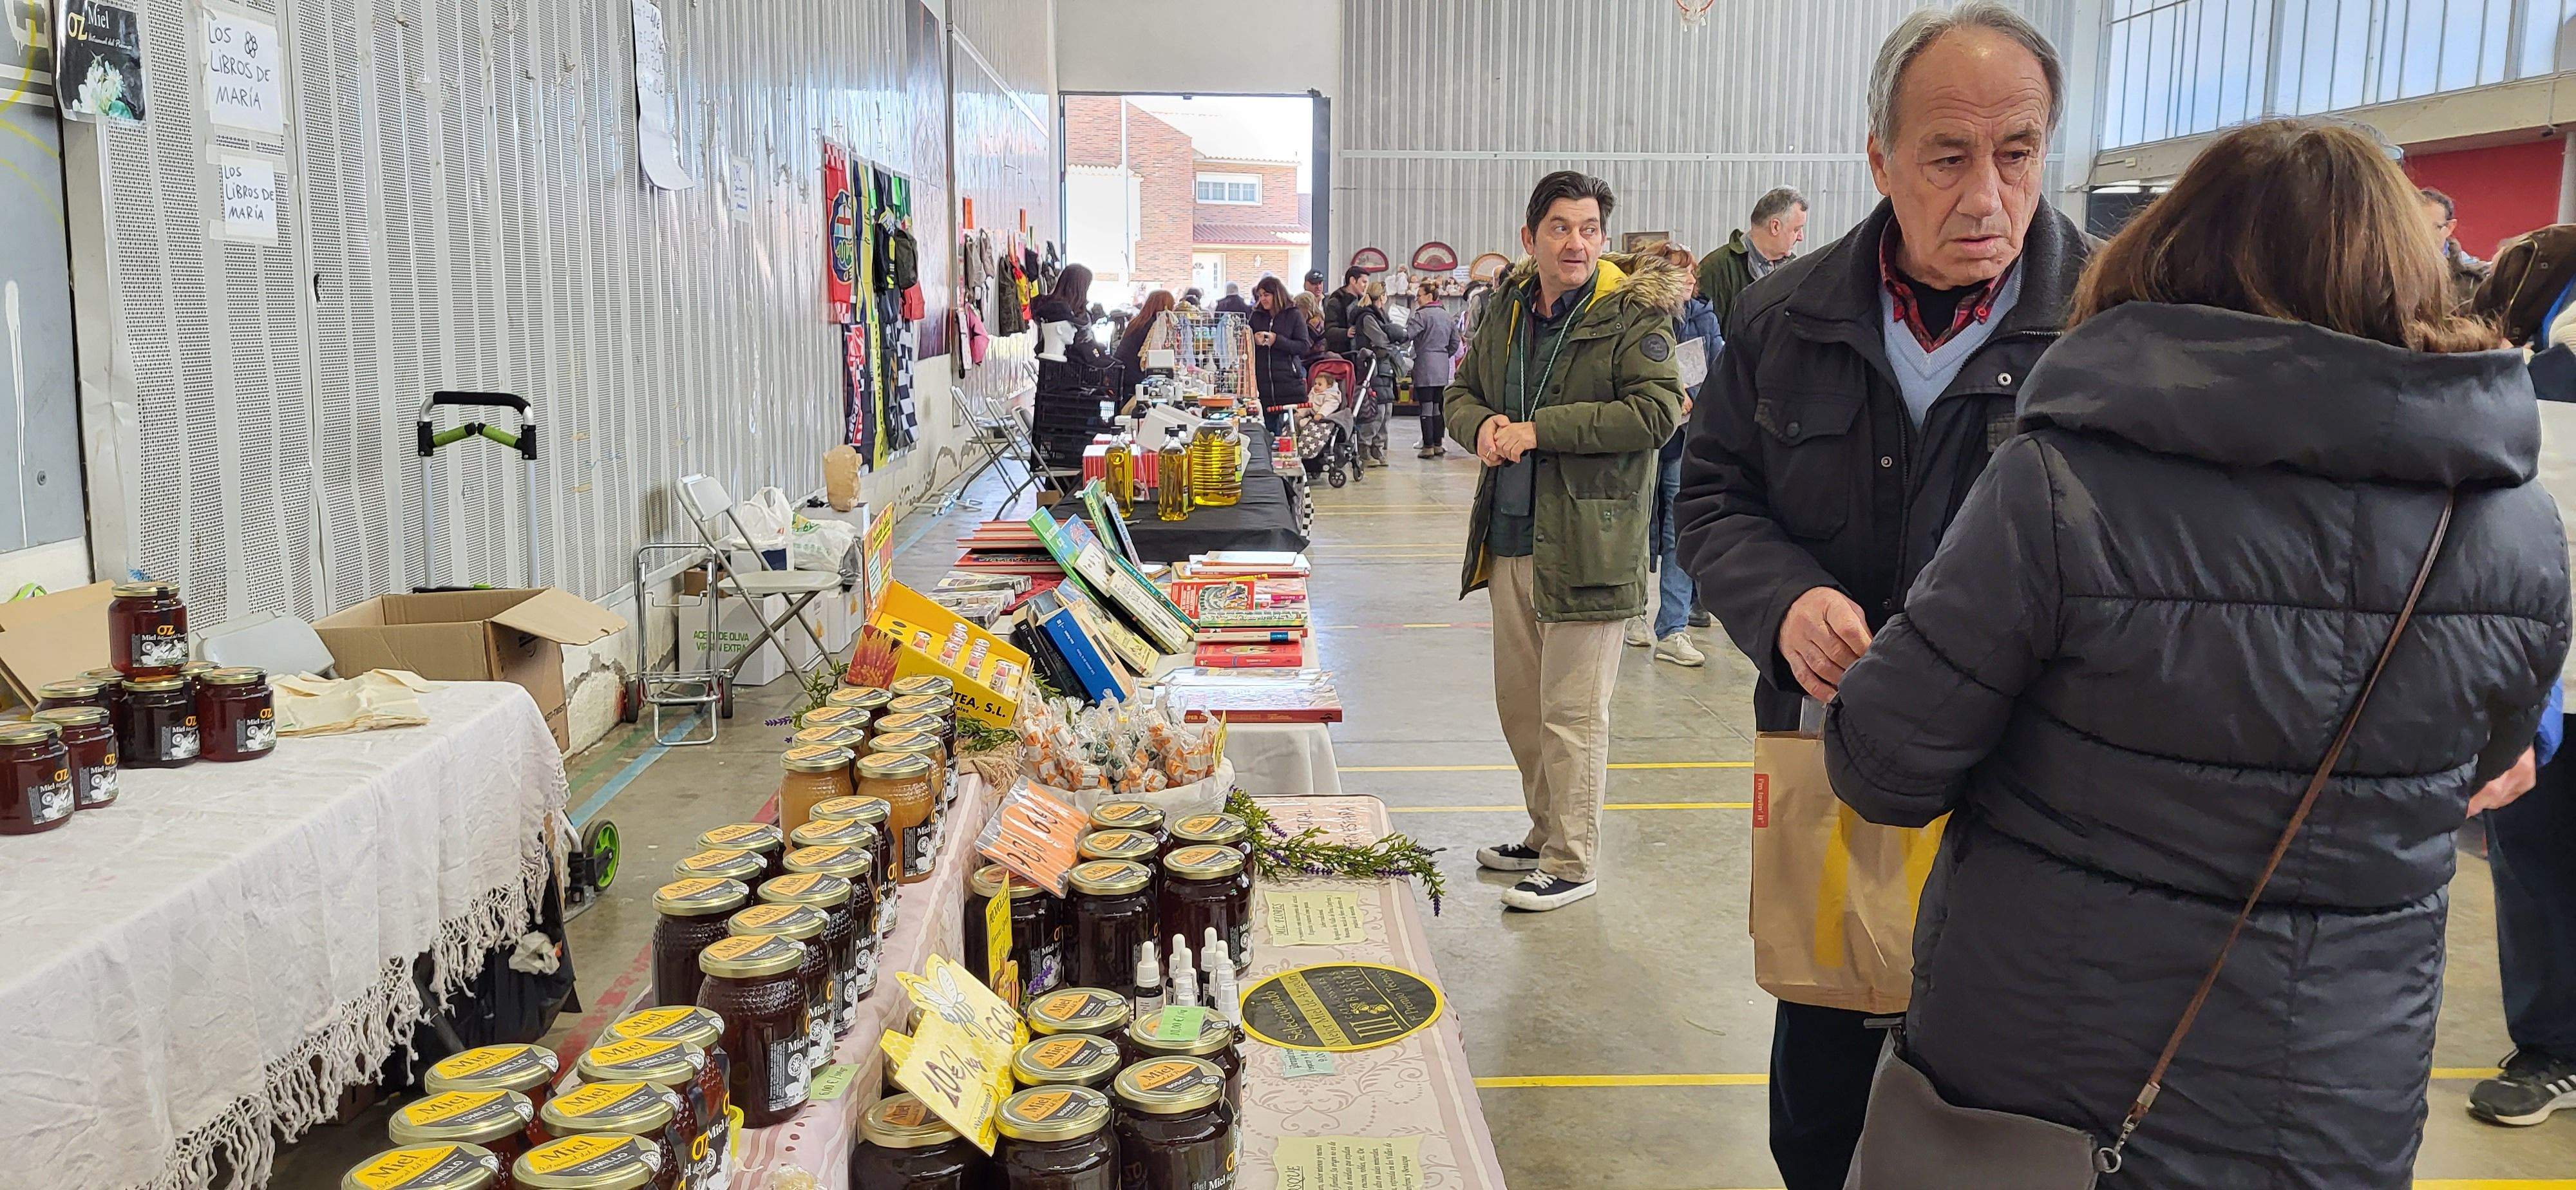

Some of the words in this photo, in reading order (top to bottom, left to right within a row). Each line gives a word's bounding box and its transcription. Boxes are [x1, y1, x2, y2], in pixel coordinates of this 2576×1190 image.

[88, 3, 109, 29] Miel
[209, 21, 232, 44] LOS
[256, 66, 270, 82] DE
[216, 86, 261, 111] MARÍA
[224, 165, 242, 180] LOS
[262, 188, 274, 201] DE
[229, 204, 264, 222] MARÍA
[719, 632, 728, 640] DE
[730, 632, 749, 641] OLIVA
[984, 703, 1006, 718] S.L.
[39, 782, 55, 793] Miel
[916, 826, 931, 836] Miel
[800, 846, 831, 858] Miel
[668, 881, 702, 892] Miel
[776, 877, 804, 890] Miel
[746, 907, 779, 920] Miel
[1271, 903, 1285, 923] FLORES
[1239, 921, 1250, 932] Miel
[1275, 925, 1288, 936] MIL
[716, 938, 749, 952] Miel
[856, 935, 871, 949] Miel
[1041, 943, 1054, 956] Miel
[1288, 975, 1312, 998] Aragón
[1330, 971, 1359, 1003] Biescas
[1341, 969, 1370, 992] 2017
[1049, 998, 1072, 1015] Miel
[1301, 997, 1317, 1006] de
[1396, 992, 1419, 1015] Premio
[809, 1003, 826, 1018] Miel
[1262, 990, 1306, 1041] Seleccionado
[1305, 1008, 1328, 1025] Miel
[624, 1012, 665, 1032] Miel
[661, 1019, 697, 1036] TOMILLO
[1349, 1014, 1403, 1038] III
[1322, 1023, 1345, 1046] Mejor
[601, 1041, 647, 1057] Miel
[787, 1036, 805, 1053] Miel
[1039, 1043, 1066, 1059] Miel
[449, 1051, 497, 1070] Miel
[486, 1057, 528, 1076] TOMILLO
[632, 1053, 676, 1067] TOMILLO
[1141, 1062, 1175, 1081] Miel
[418, 1094, 469, 1115] Miel
[564, 1087, 612, 1107] Miel
[608, 1095, 650, 1113] TOMILLO
[1023, 1097, 1052, 1113] Miel
[455, 1104, 503, 1123] TOMILLO
[708, 1119, 724, 1140] Miel
[540, 1140, 594, 1163] Miel
[367, 1154, 421, 1178] Miel
[578, 1152, 629, 1173] TOMILLO
[422, 1160, 465, 1184] TOMILLO
[1208, 1174, 1226, 1189] Miel
